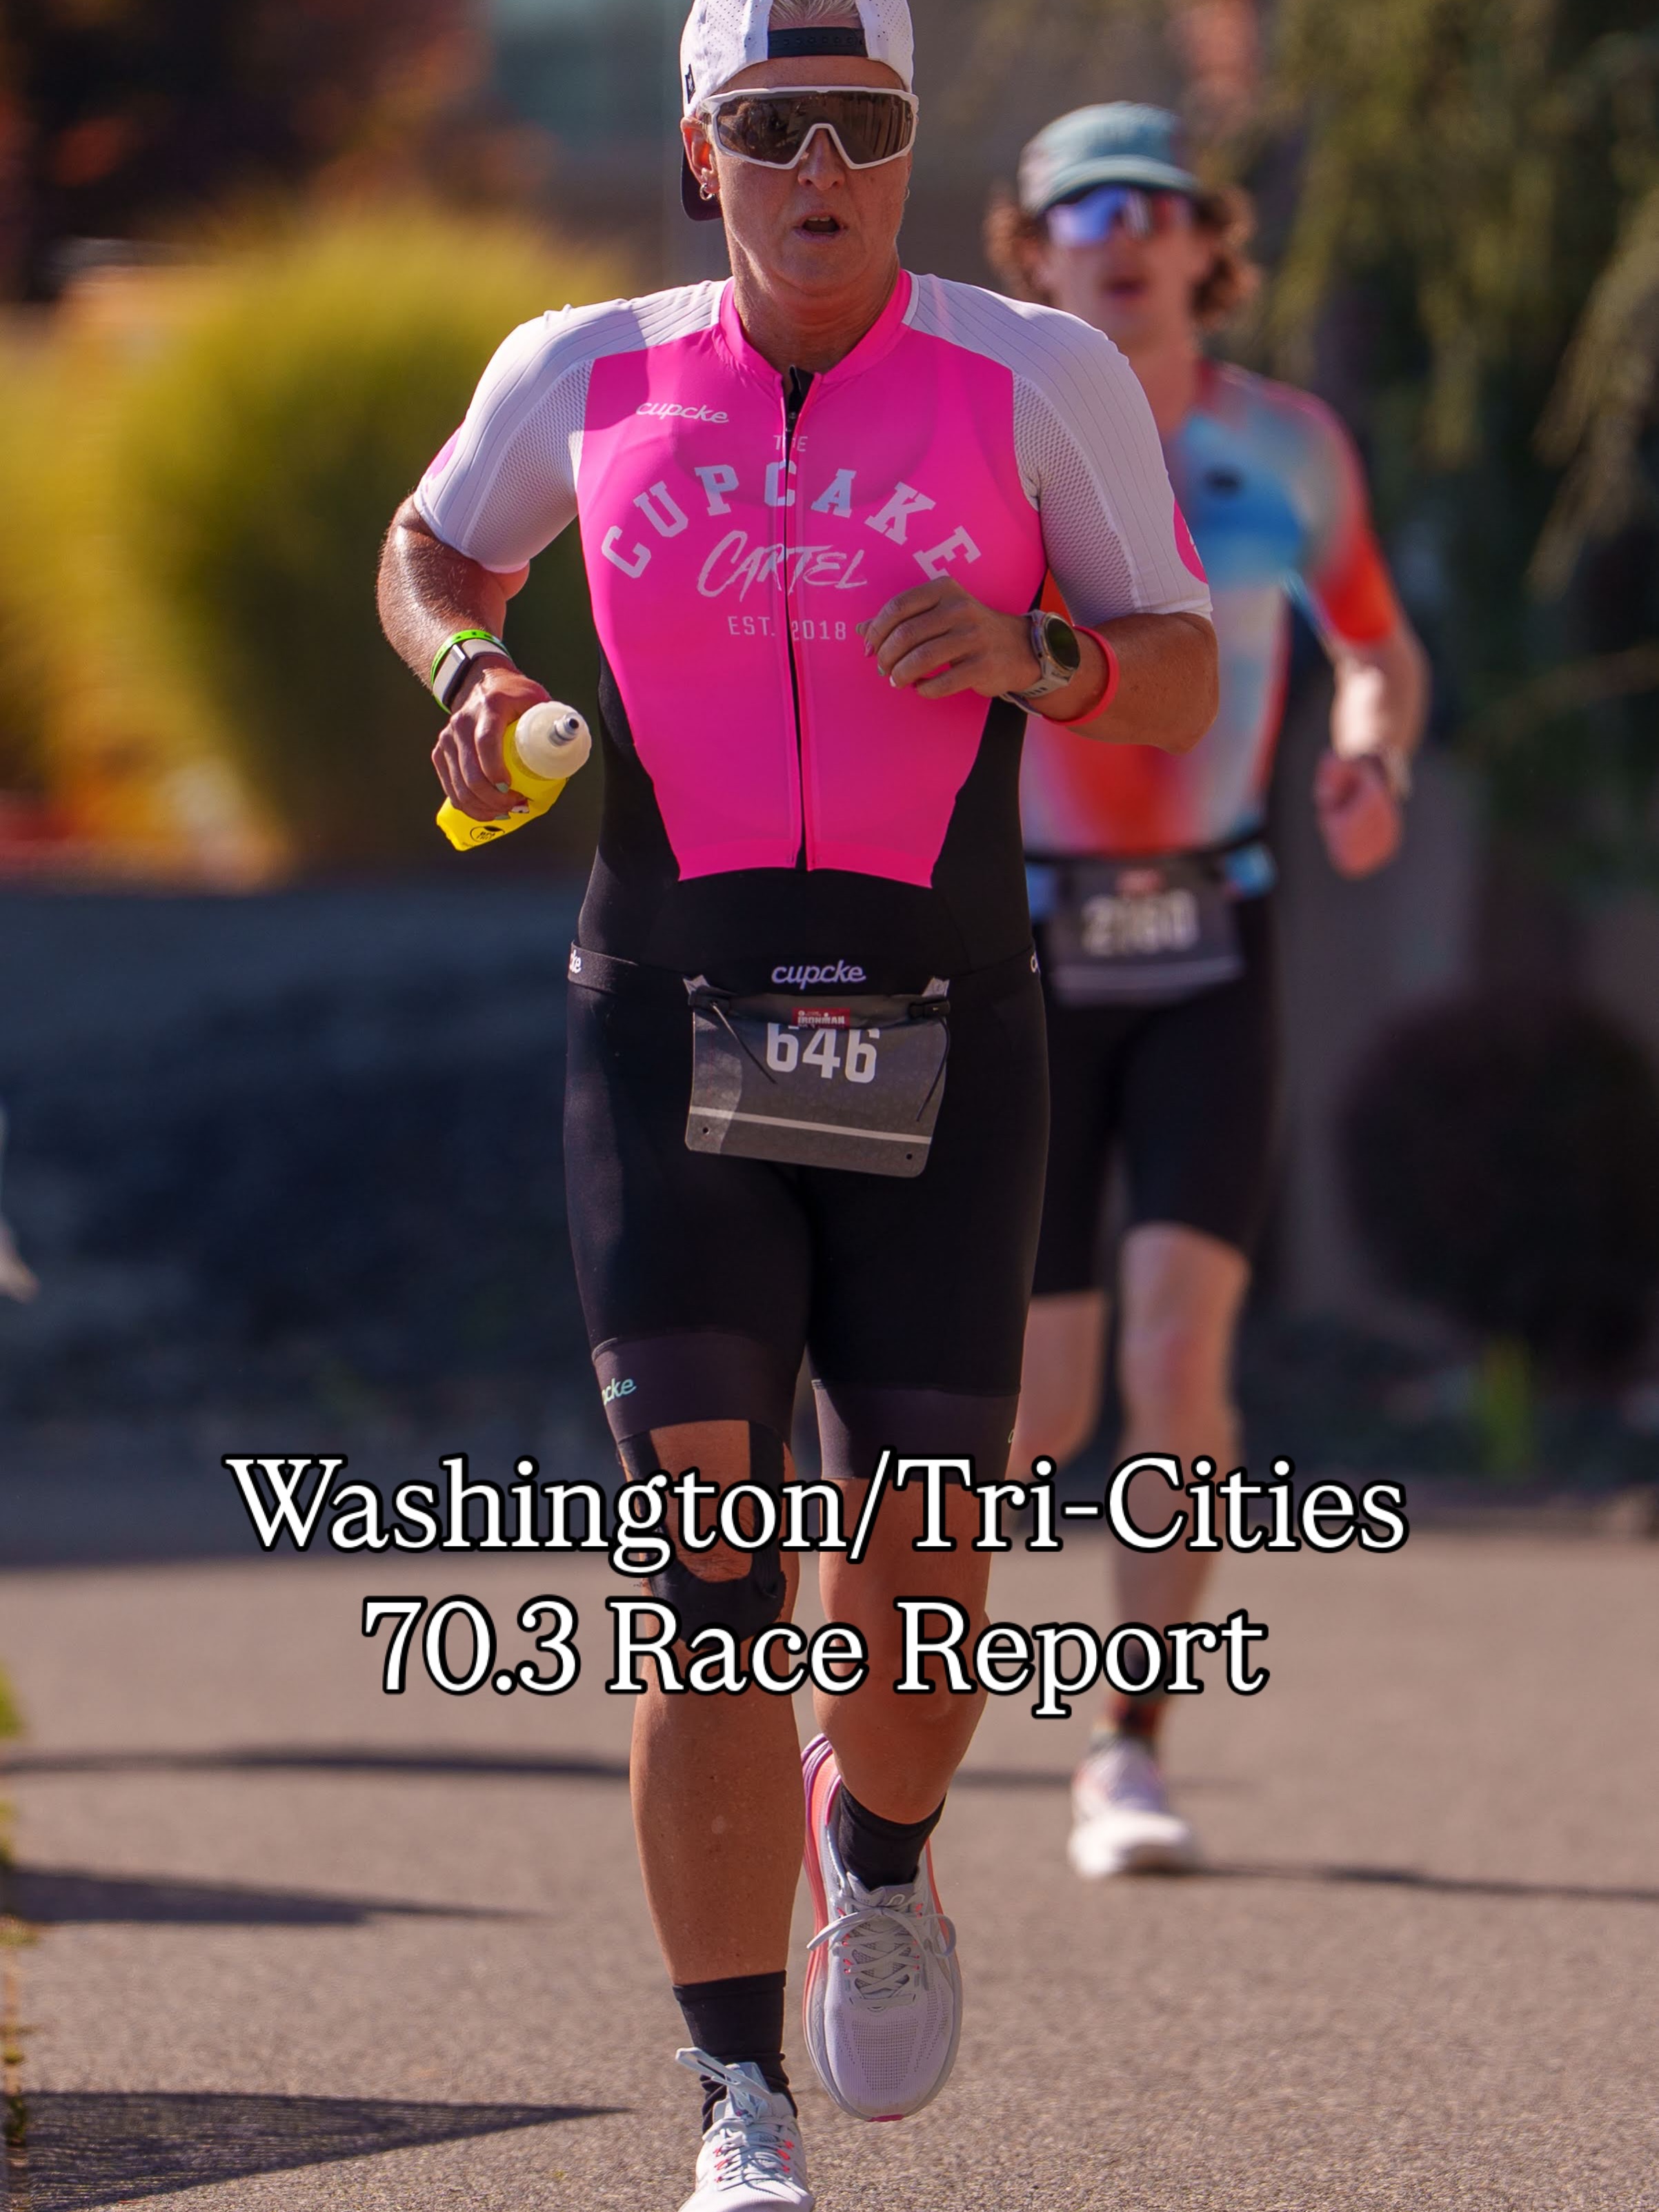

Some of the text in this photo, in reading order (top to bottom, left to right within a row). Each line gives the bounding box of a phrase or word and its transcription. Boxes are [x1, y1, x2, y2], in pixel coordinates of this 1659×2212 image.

[636, 402, 729, 423] cupcke
[601, 460, 982, 580] CUPCAKE
[697, 530, 867, 602] CARTEL
[728, 616, 846, 641] EST. 2018
[771, 959, 866, 990] cupcke
[797, 1013, 845, 1025] IRONMAN
[766, 1023, 880, 1083] 646
[602, 1378, 637, 1405] cke
